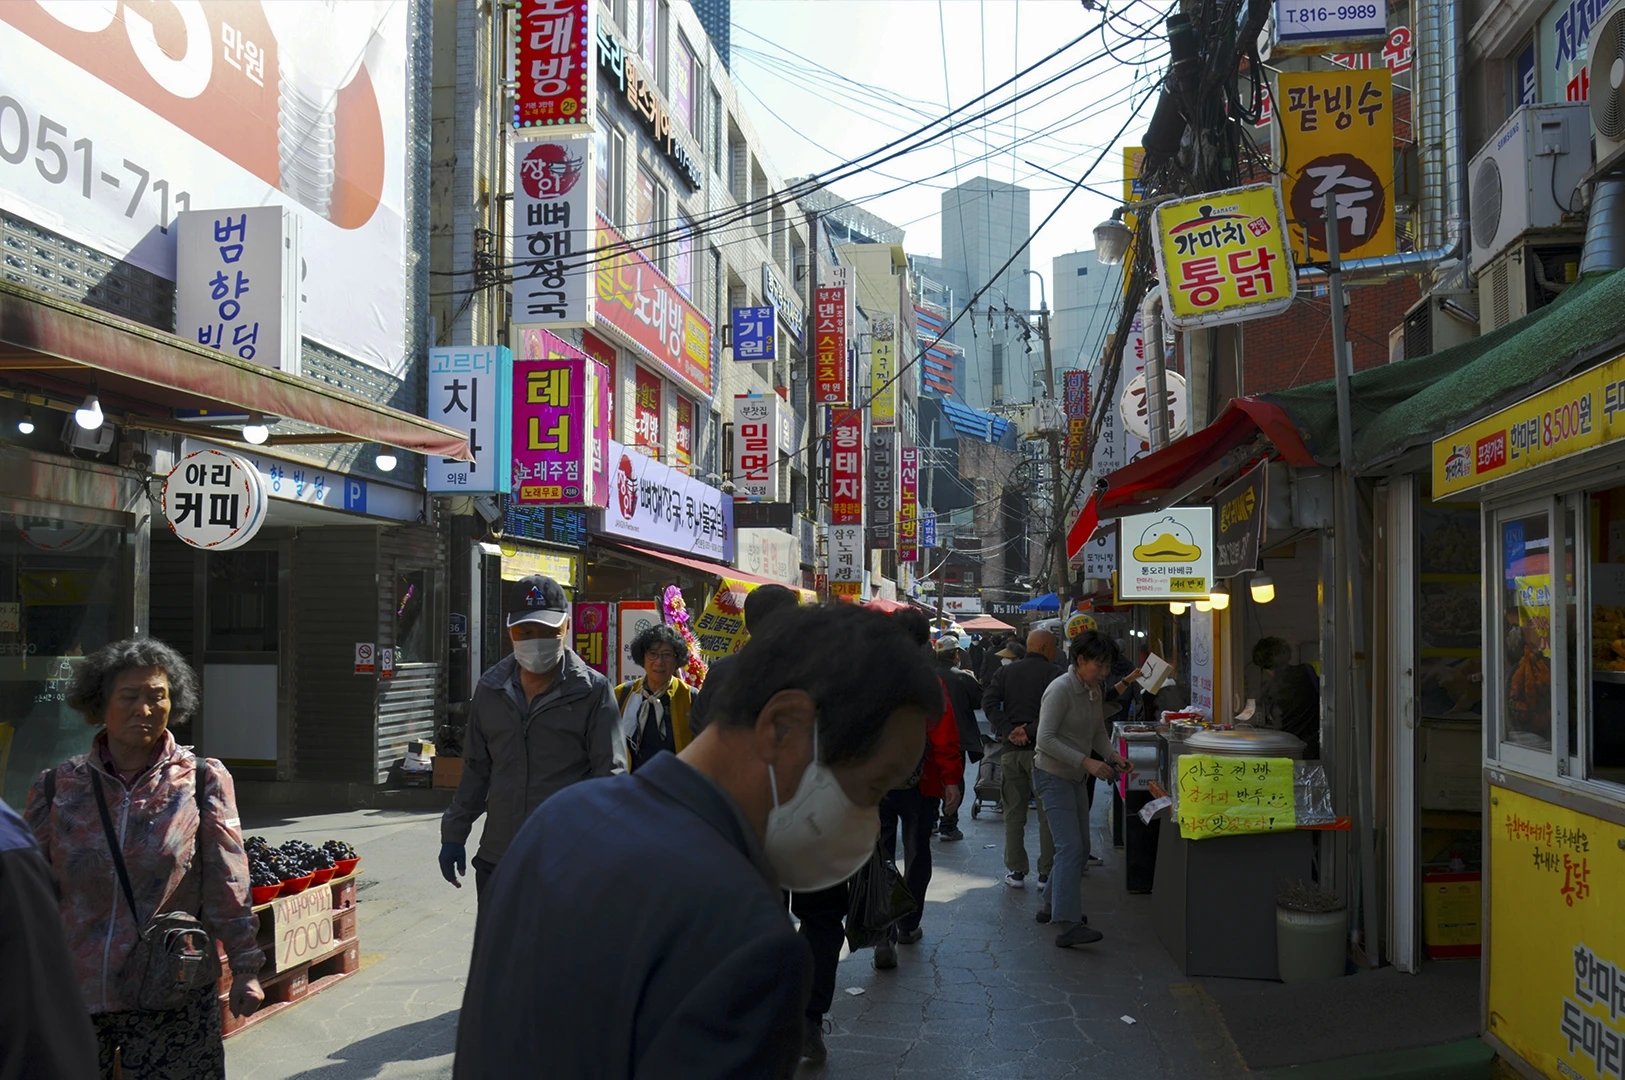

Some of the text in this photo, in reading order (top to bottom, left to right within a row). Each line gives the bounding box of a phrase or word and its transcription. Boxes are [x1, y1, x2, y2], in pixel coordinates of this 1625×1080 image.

[1286, 4, 1376, 24] T.816-9989
[221, 22, 264, 87] 만원
[562, 101, 576, 112] 2F
[1288, 80, 1383, 132] 팥빙수
[1497, 122, 1520, 151] SAMSUNG
[522, 158, 560, 198] 장인
[1212, 204, 1239, 216] GAMACHI
[1306, 164, 1373, 237] 죽
[1174, 222, 1246, 256] 가마치
[526, 202, 572, 319] 뼈해장국
[1178, 246, 1277, 307] 통닭
[819, 292, 842, 301] 부산
[634, 267, 682, 357] 노래방
[738, 309, 771, 319] 부전
[739, 321, 764, 357] 기원
[766, 335, 773, 353] 3F
[818, 303, 836, 380] 댄스 스포츠
[431, 351, 494, 375] 고르다
[821, 383, 841, 392] 학원
[526, 368, 572, 454] 테너
[742, 406, 768, 416] 부잣집
[1510, 392, 1592, 461] 한마리 8,500원
[741, 423, 769, 481] 밀면
[835, 425, 859, 500] 황태자
[1477, 437, 1504, 467] 포장가격
[184, 463, 232, 489] 아리
[447, 473, 468, 485] 의원
[517, 460, 579, 482] 노래주점
[902, 450, 916, 484] 부산
[348, 482, 361, 510] P
[524, 487, 559, 498] 노래무료
[565, 487, 578, 496] 지하
[174, 492, 239, 530] 커피
[902, 486, 916, 538] 노래방
[834, 529, 856, 540] 삼우
[837, 542, 854, 580] 노래방
[1087, 553, 1114, 562] 도가니탕
[1141, 566, 1193, 576] 통오리 바베큐
[838, 583, 857, 594] 기원
[697, 612, 743, 635] 콩나물국밥
[1555, 825, 1590, 853] 특허받은
[1532, 846, 1591, 908] 국내산 통닭
[283, 917, 333, 965] 7000
